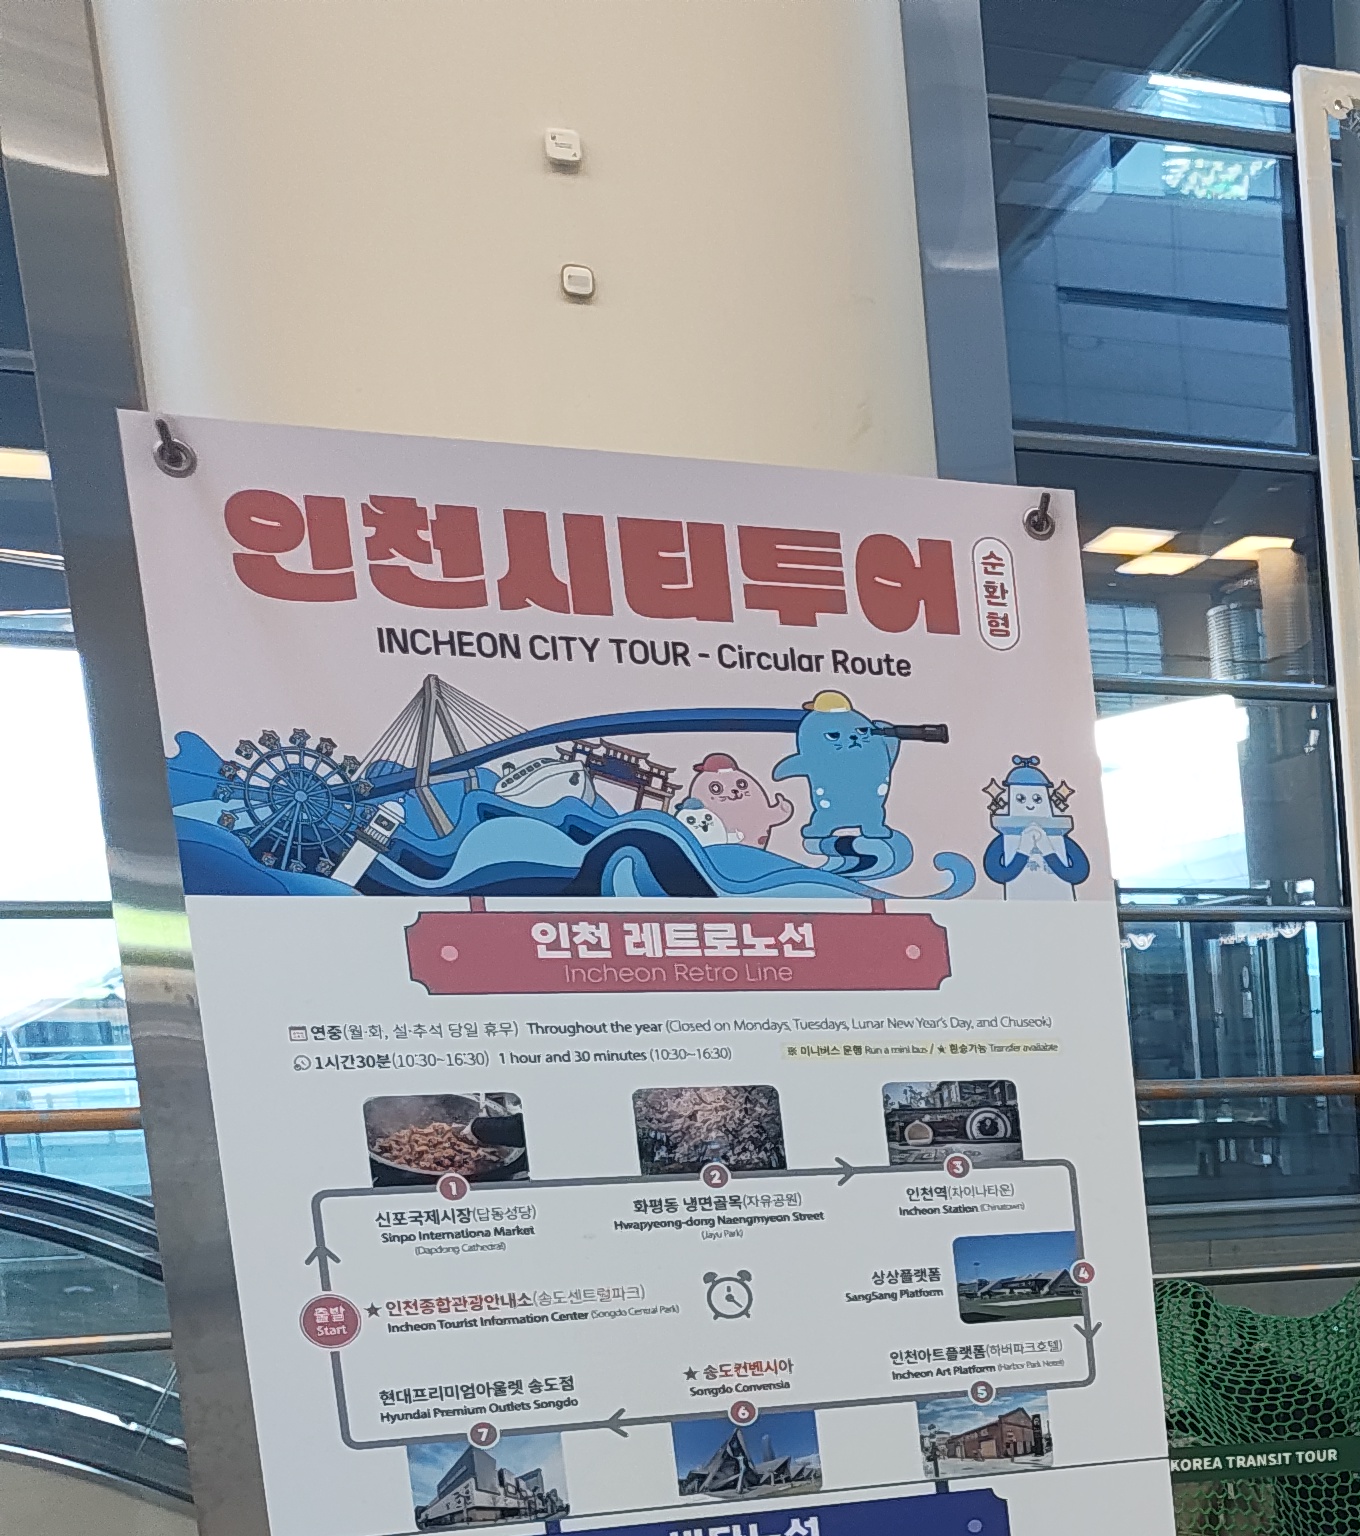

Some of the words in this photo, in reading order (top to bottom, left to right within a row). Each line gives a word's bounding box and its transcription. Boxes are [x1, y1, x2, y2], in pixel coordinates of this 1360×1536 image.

[223, 488, 961, 637] 인천시티투어
[377, 628, 521, 665] INCHEON
[528, 634, 600, 665] CITY
[609, 637, 691, 668] TOUR
[717, 644, 825, 675] Circular
[832, 649, 912, 679] Route
[531, 922, 614, 960] 인천
[623, 922, 816, 960] 레트로노선
[564, 963, 664, 985] Incheon
[673, 963, 737, 985] Retro
[746, 962, 793, 984] Line
[448, 1023, 479, 1038] 당일
[527, 1021, 608, 1036] Throughout
[611, 1021, 632, 1034] the
[635, 1022, 662, 1035] year
[714, 1020, 731, 1031] on
[852, 1018, 884, 1029] Lunar
[888, 1018, 914, 1029] New
[976, 1016, 997, 1028] and
[899, 1205, 940, 1216] Incheon
[317, 1325, 348, 1336] Start
[388, 1321, 436, 1334] Incheon
[438, 1317, 477, 1330] Tourist
[480, 1313, 549, 1328] Information
[551, 1309, 589, 1323] Center
[527, 1375, 575, 1394] 송도점
[380, 1408, 430, 1424] Hyundai
[533, 1396, 578, 1411] Songdo
[1171, 1457, 1222, 1471] KOREA
[1226, 1452, 1292, 1468] TRANSIT
[1297, 1449, 1338, 1464] TOUR
